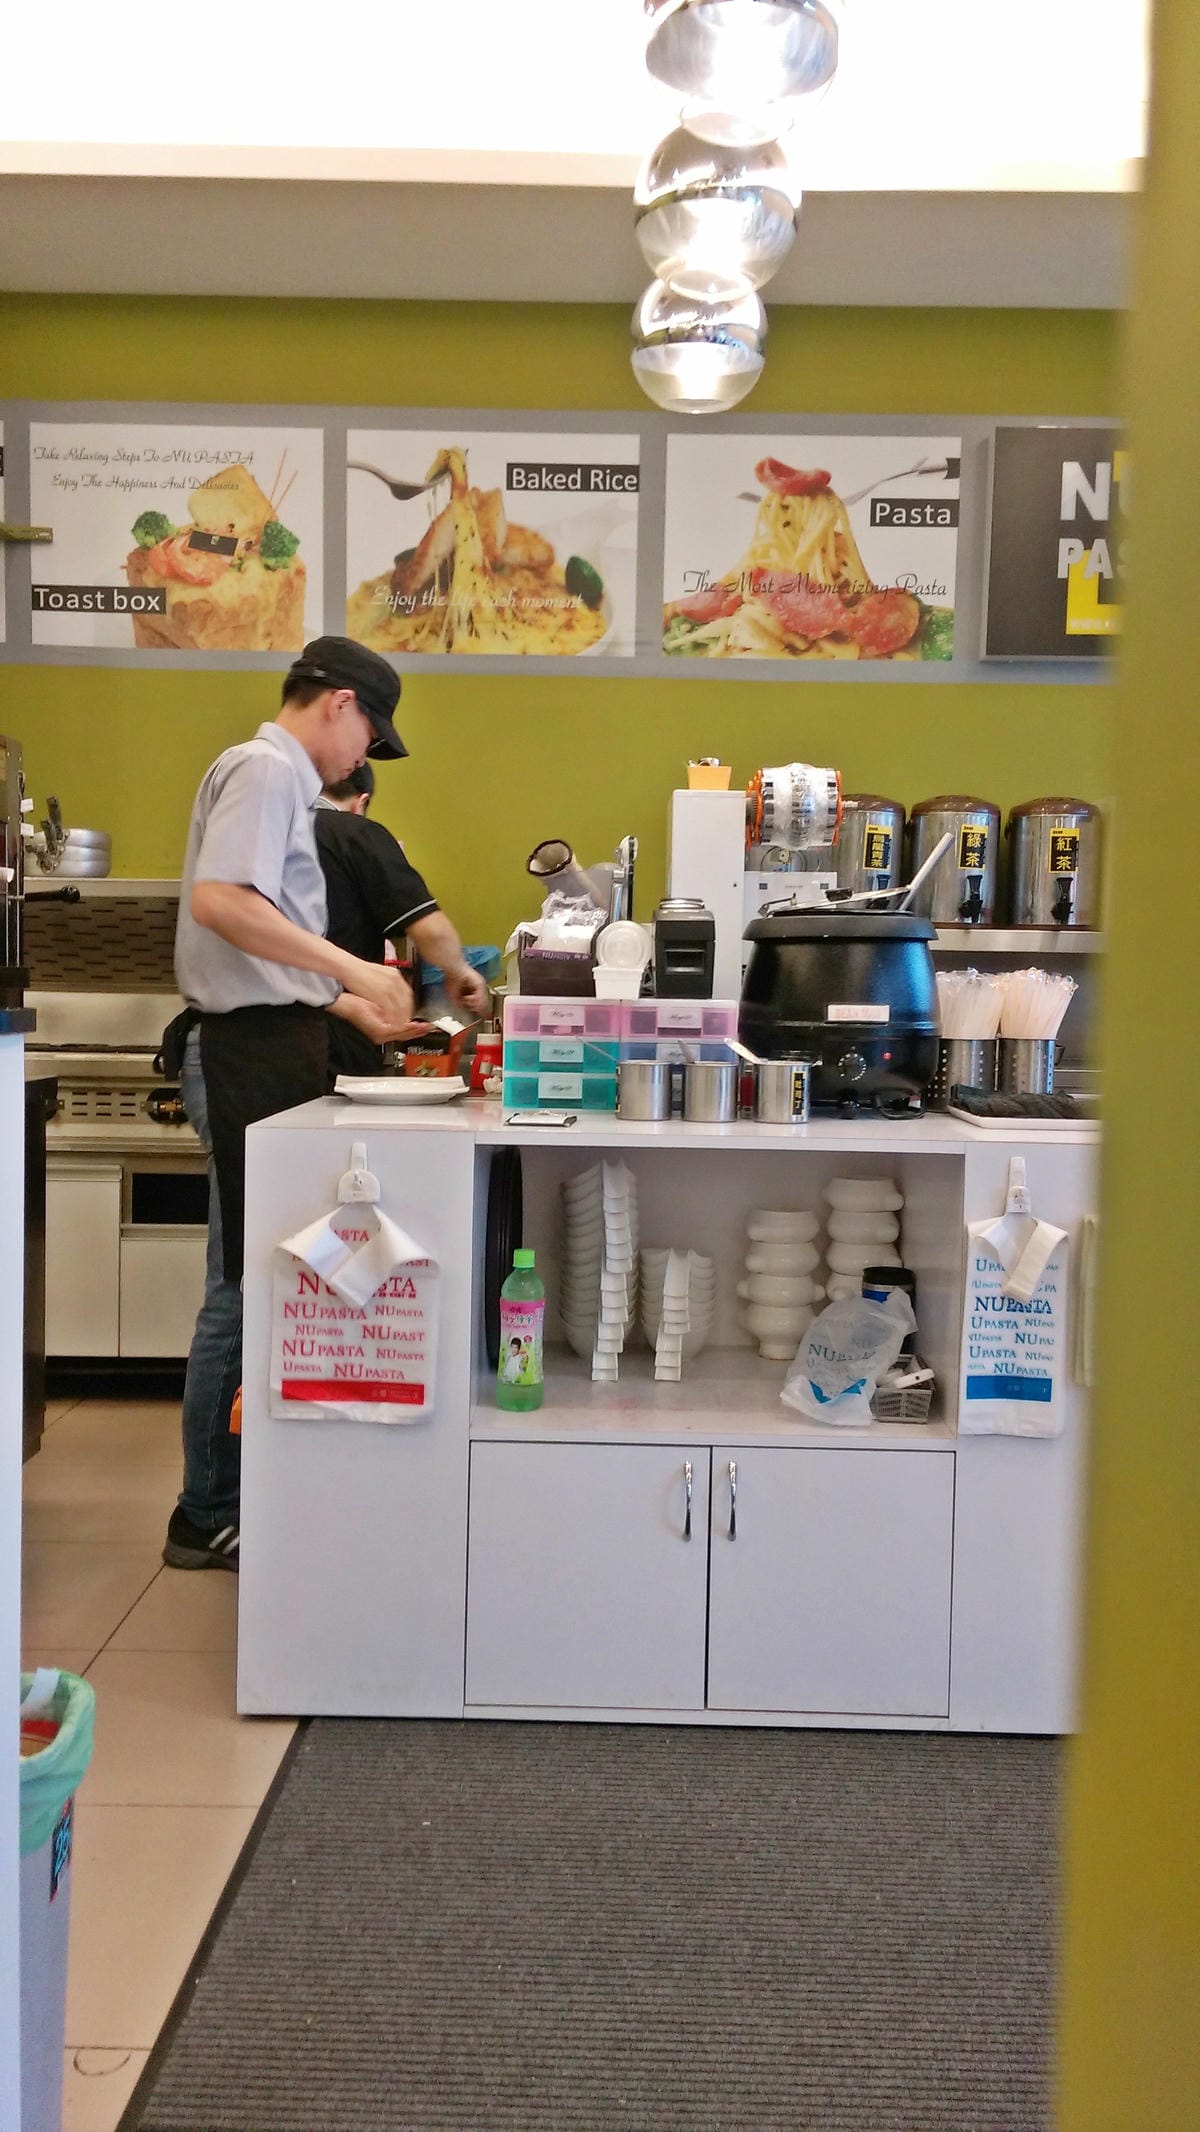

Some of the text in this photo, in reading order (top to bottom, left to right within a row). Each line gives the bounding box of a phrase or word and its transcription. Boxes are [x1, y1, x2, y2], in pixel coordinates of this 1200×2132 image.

[33, 447, 60, 460] Take
[63, 447, 109, 466] Relaxing
[111, 448, 141, 466] Steps
[143, 448, 160, 463] To
[51, 473, 79, 492] Enjoy
[81, 473, 103, 488] The
[105, 475, 158, 494] Happiness
[160, 476, 186, 490] And
[511, 467, 638, 491] Baked Rice
[875, 502, 953, 525] Pasta
[683, 569, 717, 593] The
[723, 571, 774, 594] Most
[895, 572, 948, 597] Pasta
[34, 587, 161, 612] Toast box
[370, 586, 418, 615] Enjoy
[421, 586, 446, 607] the
[521, 593, 584, 609] moment
[965, 833, 982, 867] 綠茶
[1055, 837, 1074, 871] 紅茶
